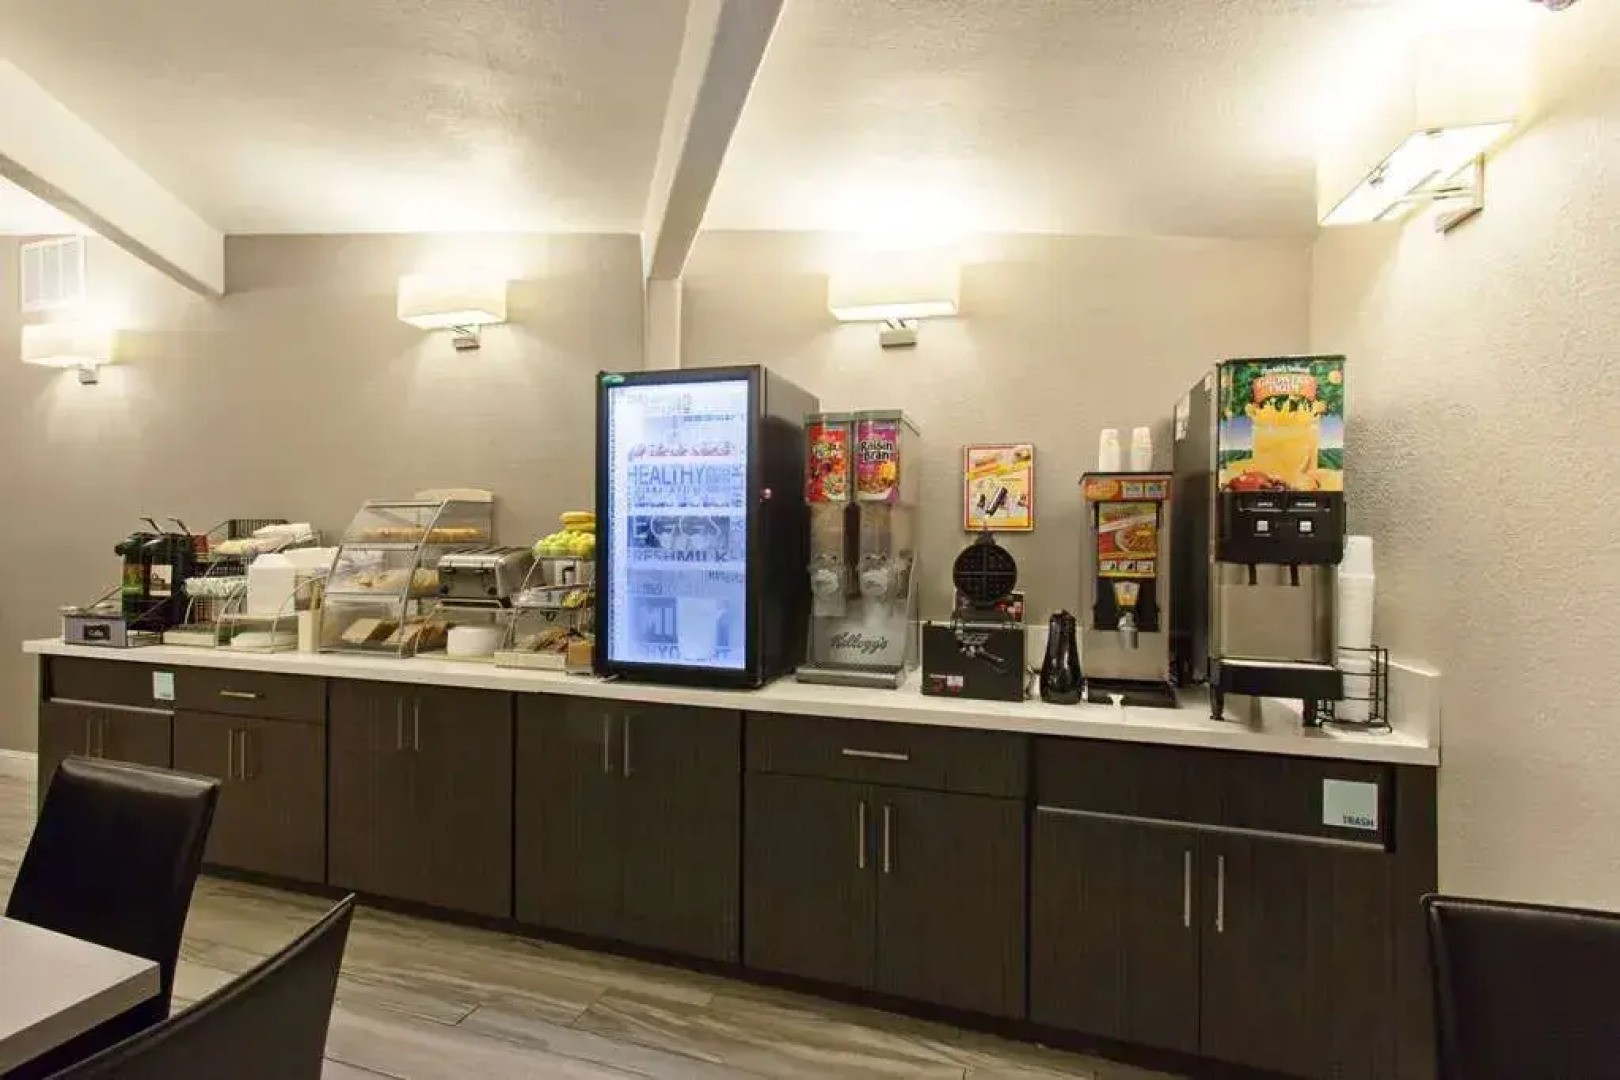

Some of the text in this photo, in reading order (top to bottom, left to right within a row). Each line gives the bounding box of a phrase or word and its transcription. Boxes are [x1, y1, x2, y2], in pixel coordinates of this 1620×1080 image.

[860, 440, 893, 452] Raisin
[627, 464, 706, 485] HEALTHY
[831, 631, 889, 655] Kellogg's
[1342, 814, 1374, 828] TRASH
